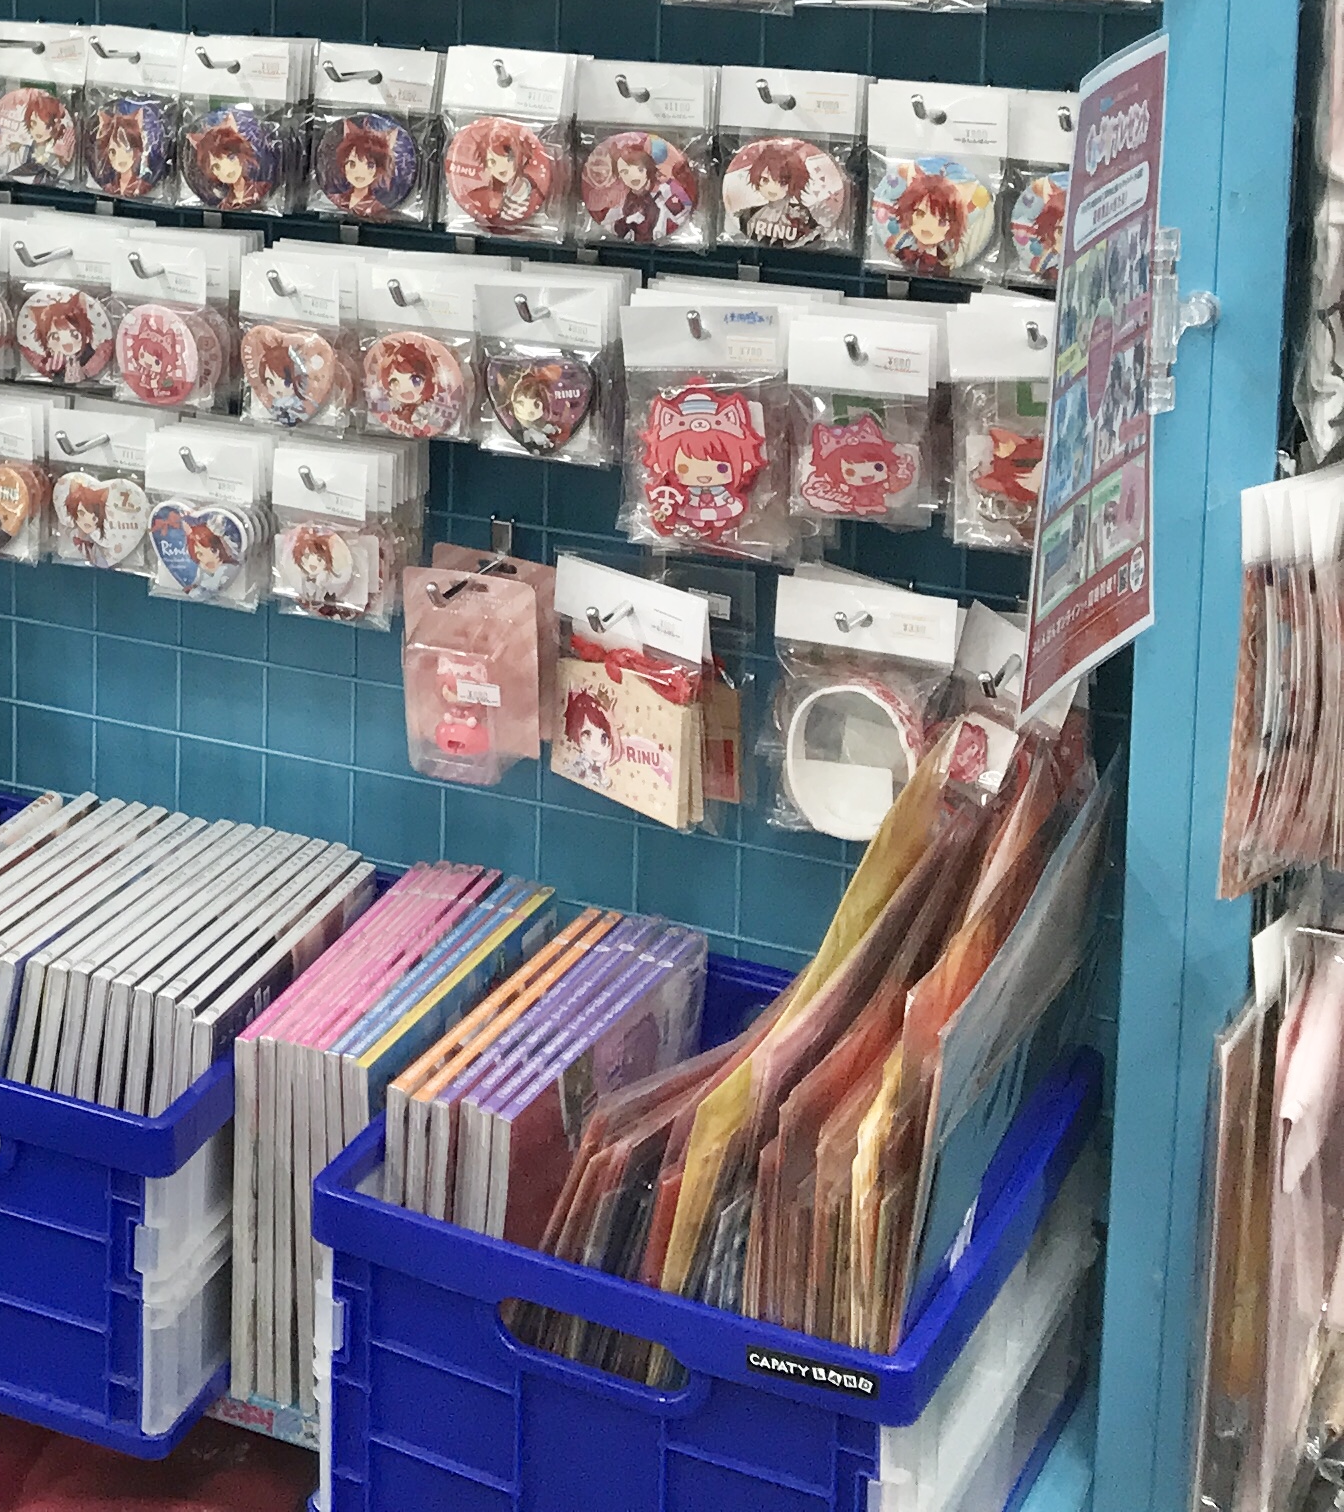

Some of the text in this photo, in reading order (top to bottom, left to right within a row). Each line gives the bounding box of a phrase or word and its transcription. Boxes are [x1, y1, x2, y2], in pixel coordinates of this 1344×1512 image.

[449, 163, 476, 177] RINU
[754, 220, 799, 241] RINU
[244, 344, 259, 380] RINU
[553, 389, 581, 400] RINU
[806, 481, 854, 506] Rinu
[626, 744, 661, 770] RINU
[749, 1351, 874, 1395] CAPATY LAND
